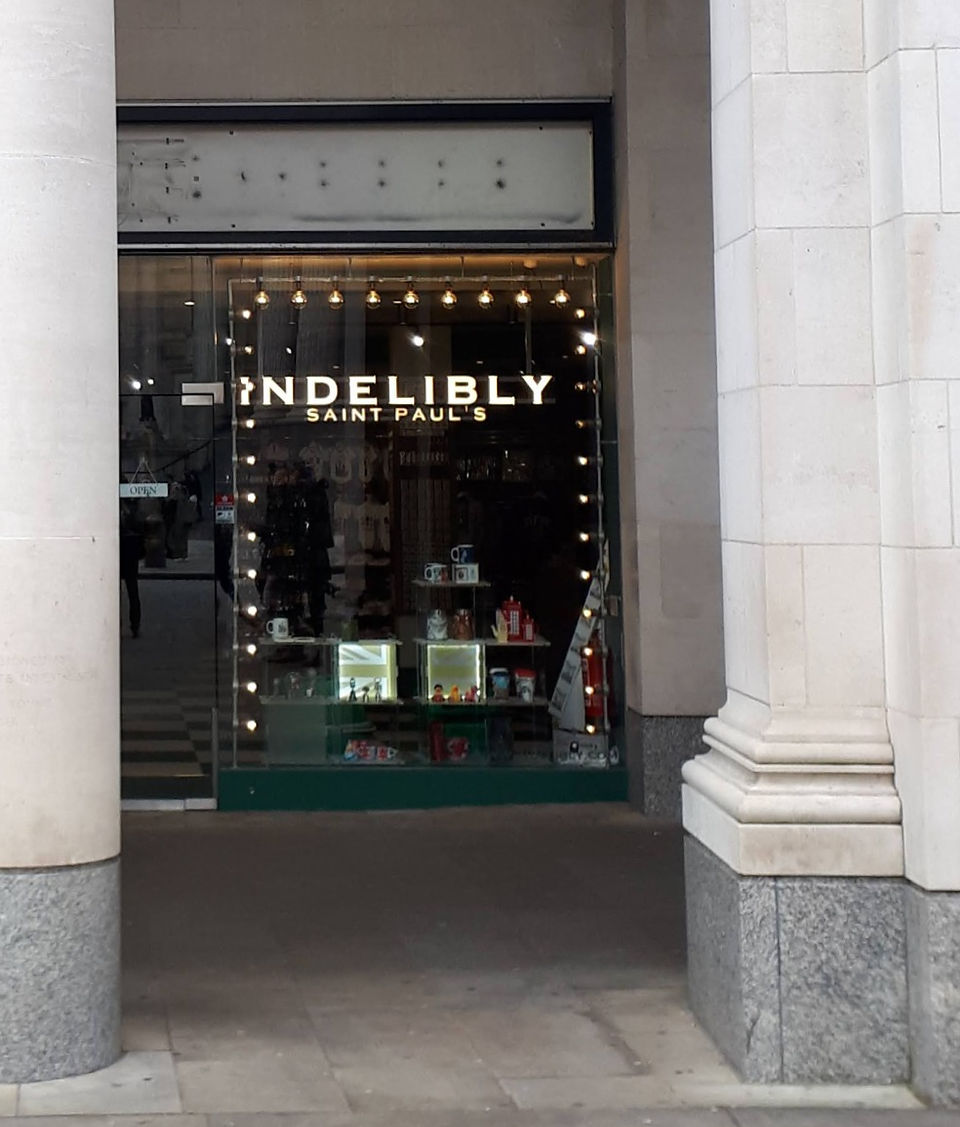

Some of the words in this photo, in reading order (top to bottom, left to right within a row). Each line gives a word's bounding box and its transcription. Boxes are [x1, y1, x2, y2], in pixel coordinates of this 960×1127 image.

[239, 375, 553, 405] INDELIBLY
[306, 407, 382, 422] SAINT
[394, 406, 487, 422] PAUL'S
[129, 485, 157, 495] OPEN
